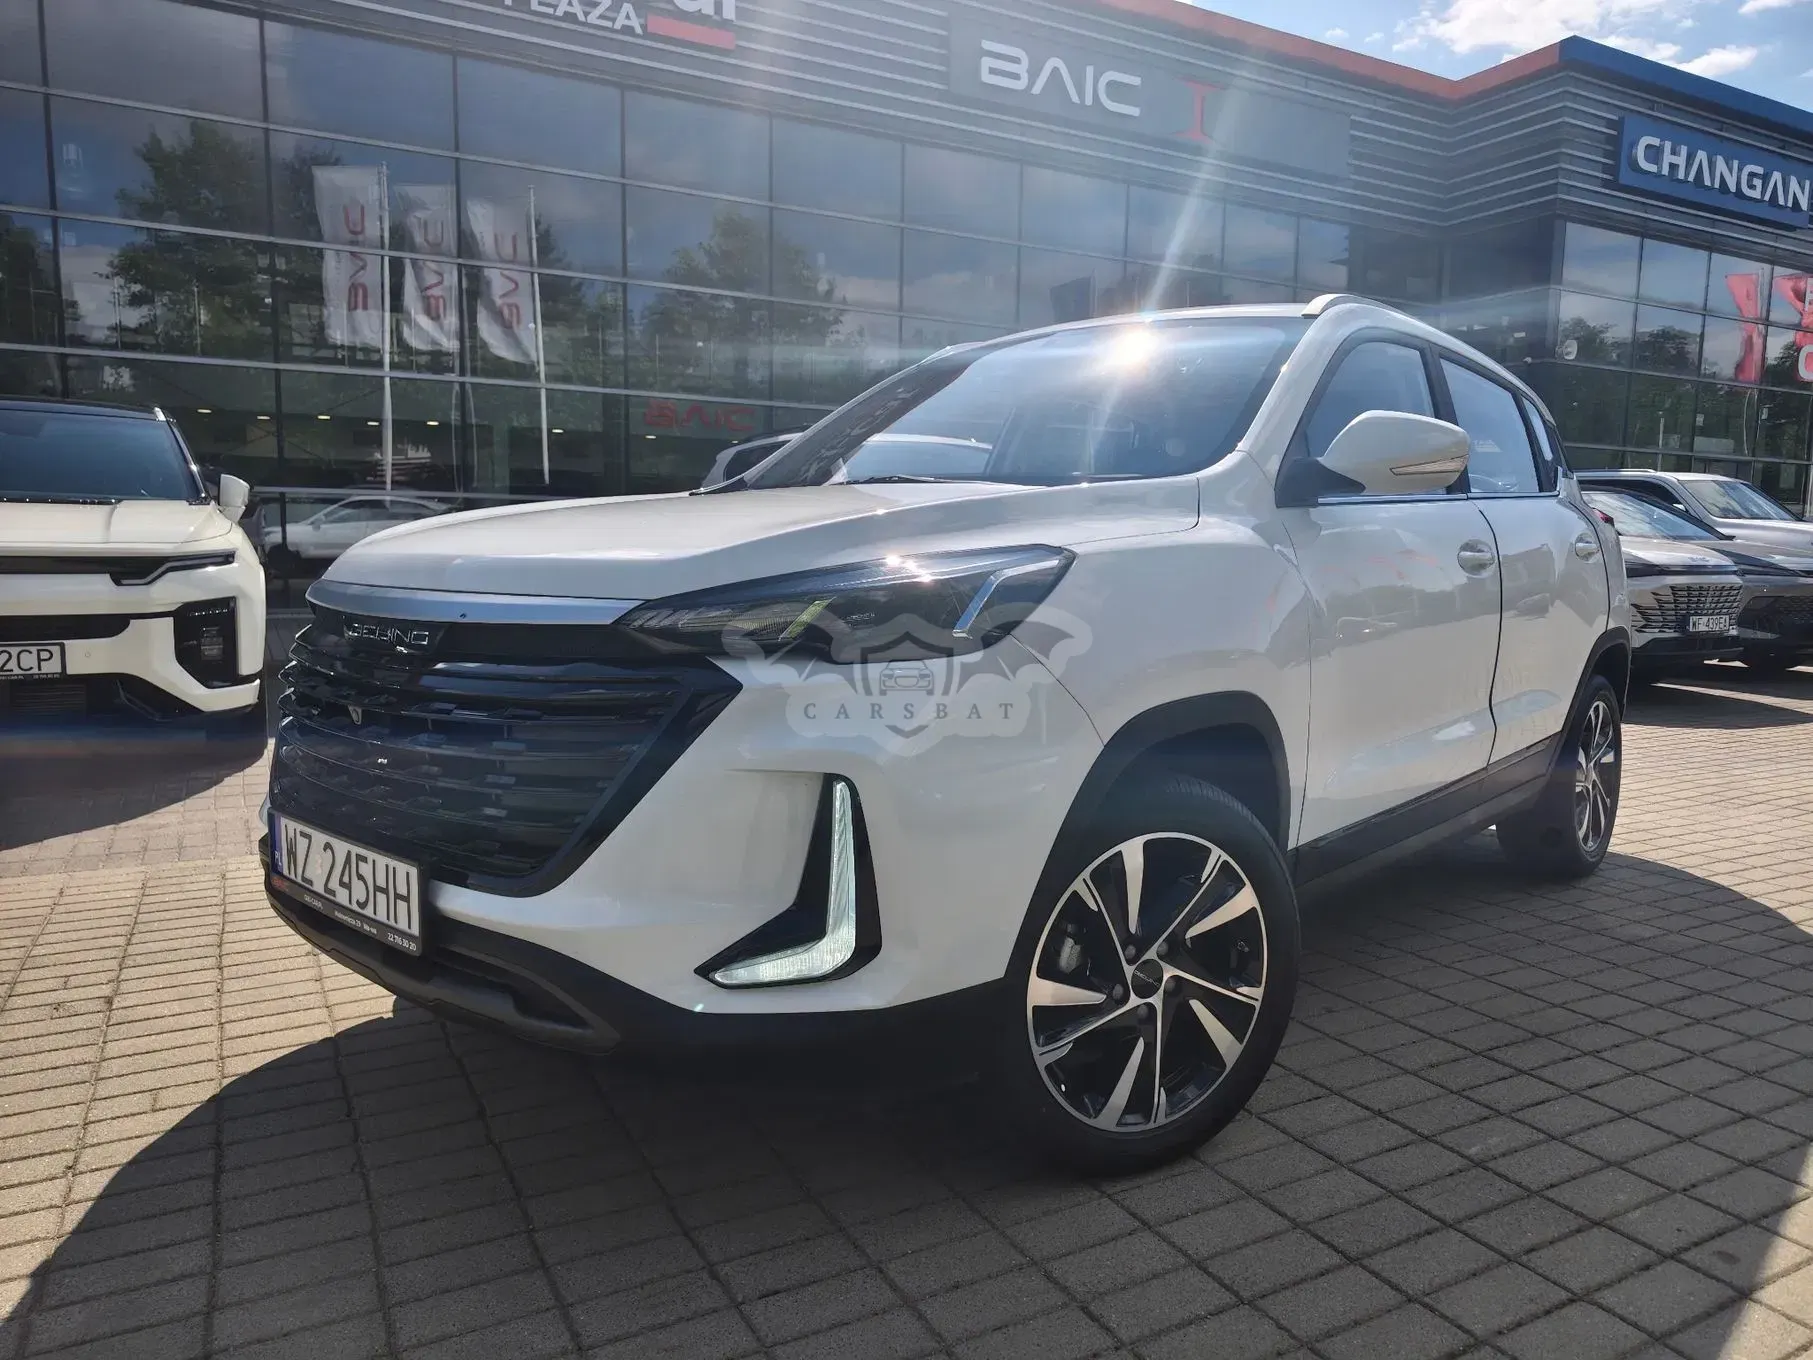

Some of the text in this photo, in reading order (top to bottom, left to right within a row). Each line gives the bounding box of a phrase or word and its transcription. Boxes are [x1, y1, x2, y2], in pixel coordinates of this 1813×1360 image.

[504, 0, 643, 35] LAZA
[980, 39, 1142, 117] BAIC
[1636, 135, 1811, 212] CHANGAN
[284, 823, 412, 930] WZ 245HH
